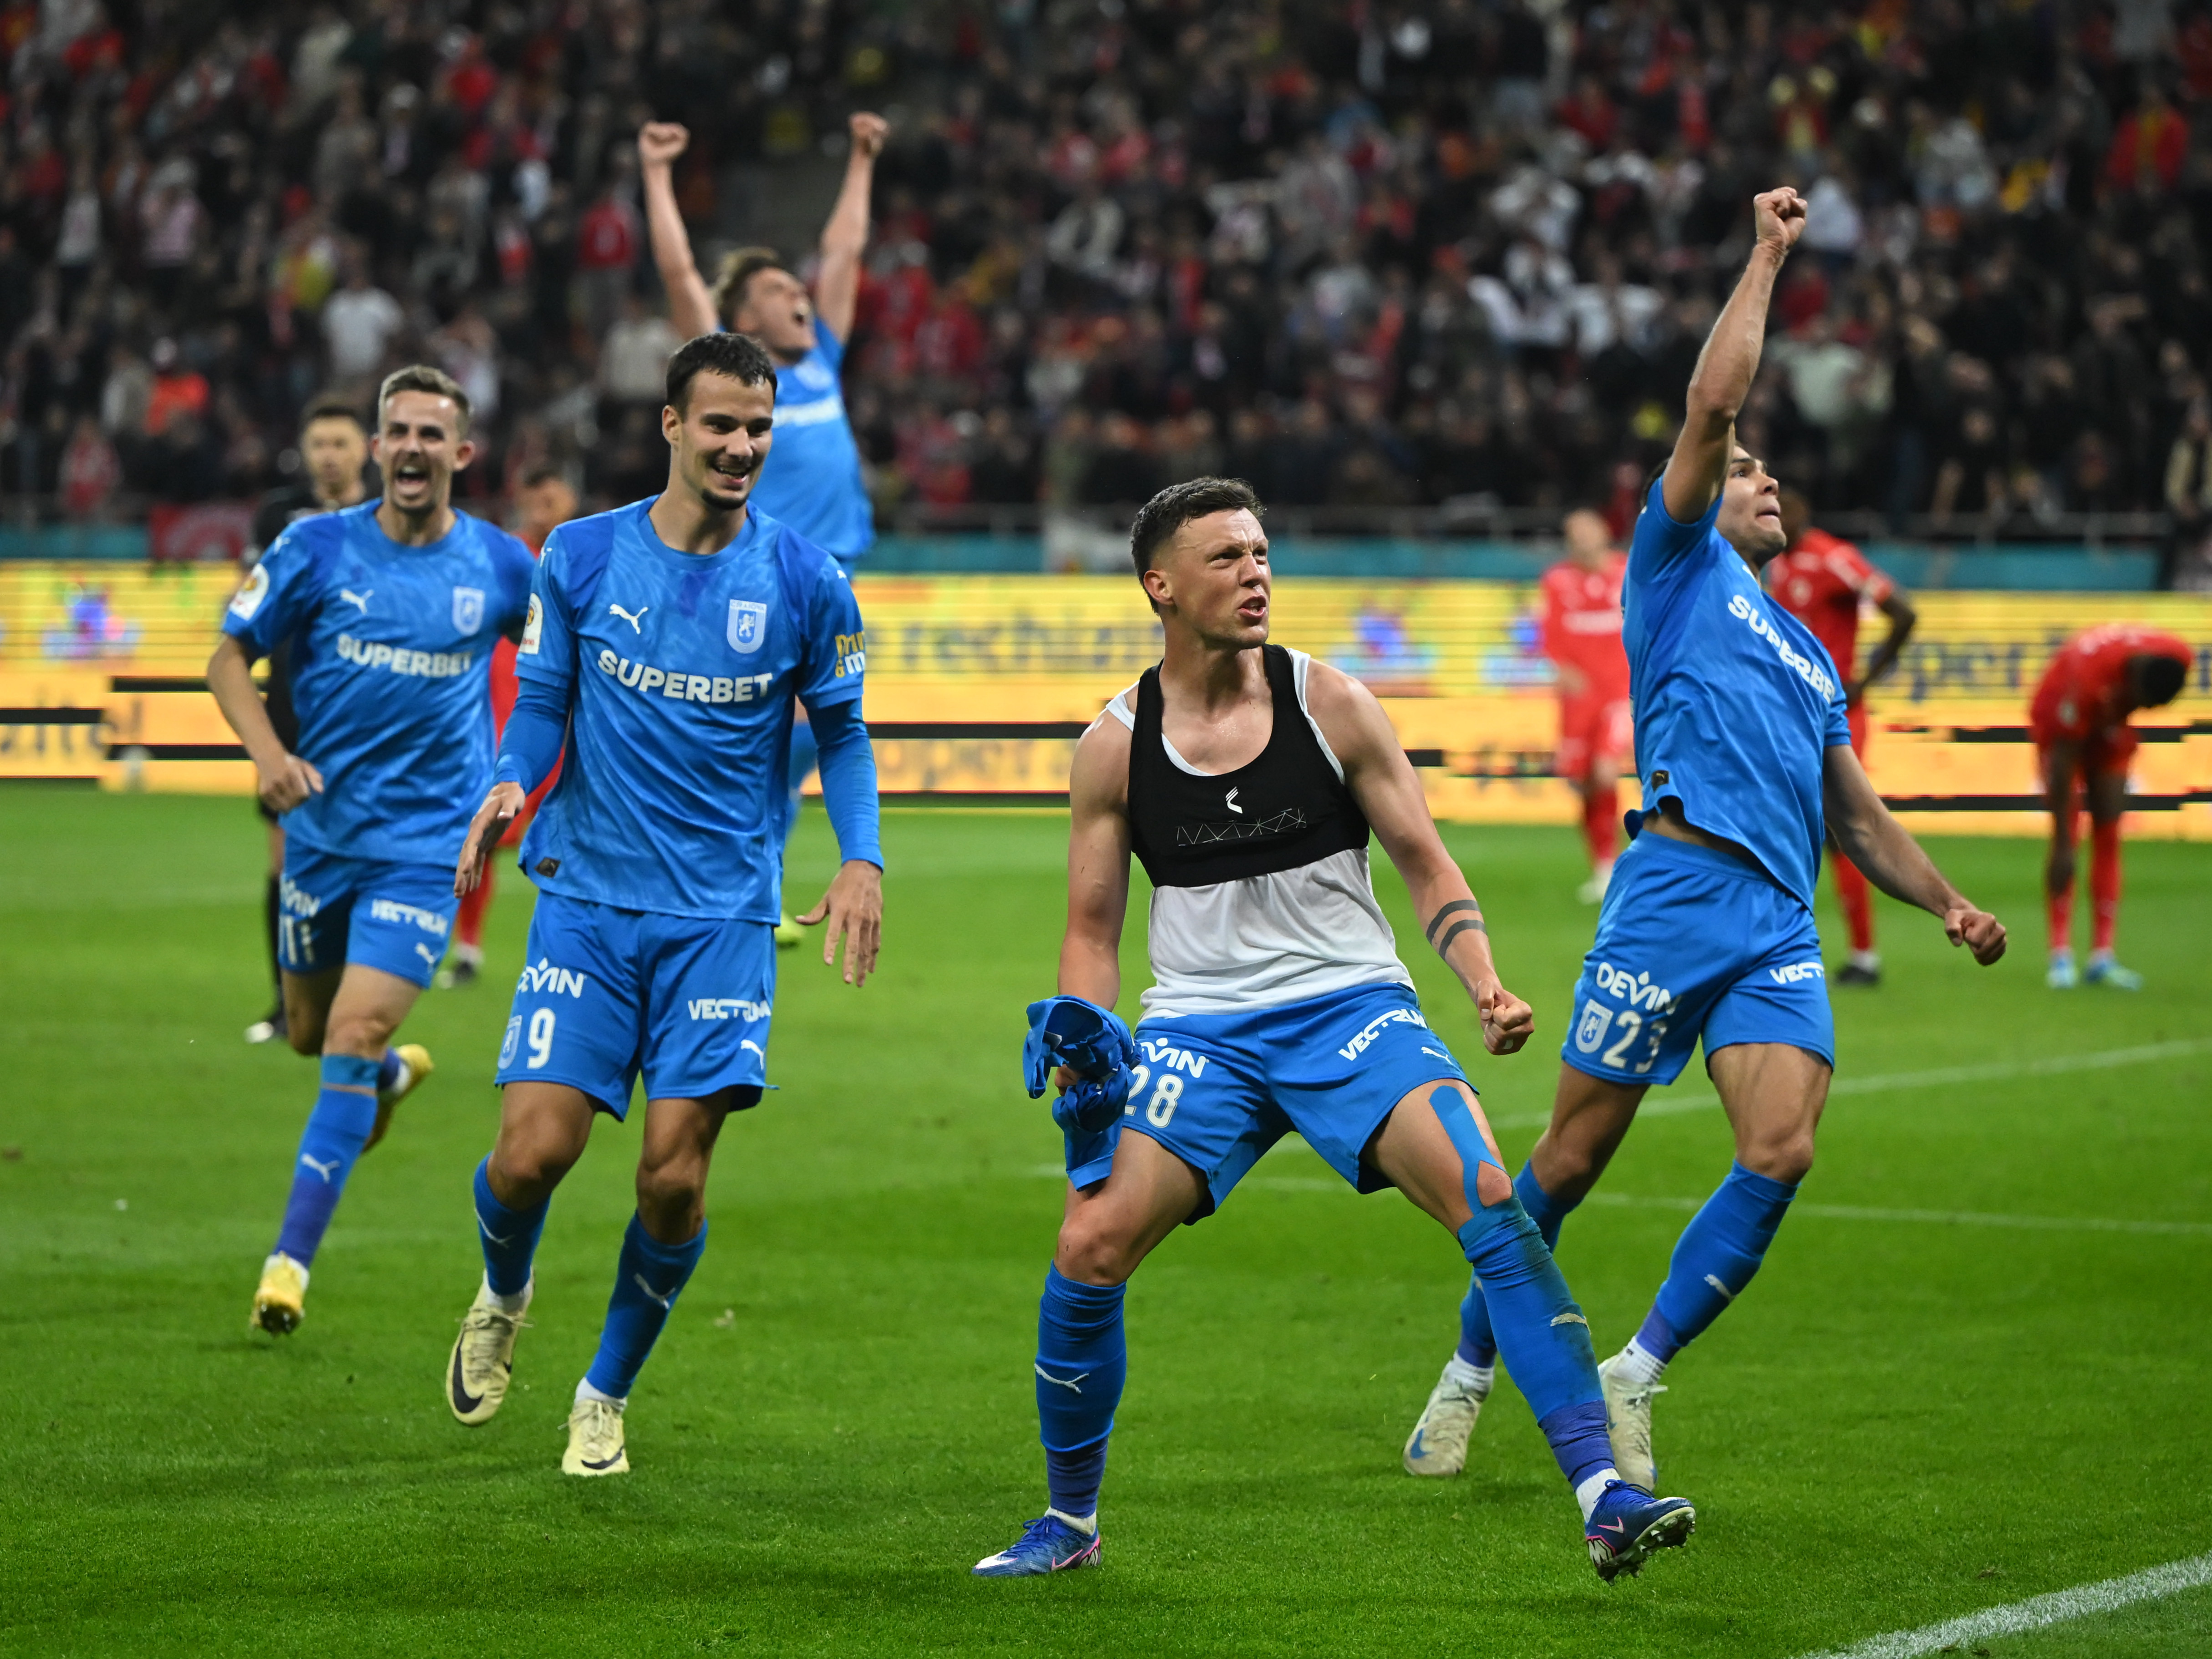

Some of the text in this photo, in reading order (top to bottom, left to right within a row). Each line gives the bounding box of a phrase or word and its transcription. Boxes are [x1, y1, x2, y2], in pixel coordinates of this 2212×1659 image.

[337, 634, 472, 678] SUPERBET
[598, 649, 773, 703] SUPERBET
[1728, 594, 1836, 705] SUPERBE
[1596, 962, 1682, 1016] DEVIN
[527, 1007, 556, 1070] 9
[1601, 1010, 1668, 1073] 23
[1125, 1065, 1184, 1128] 28
